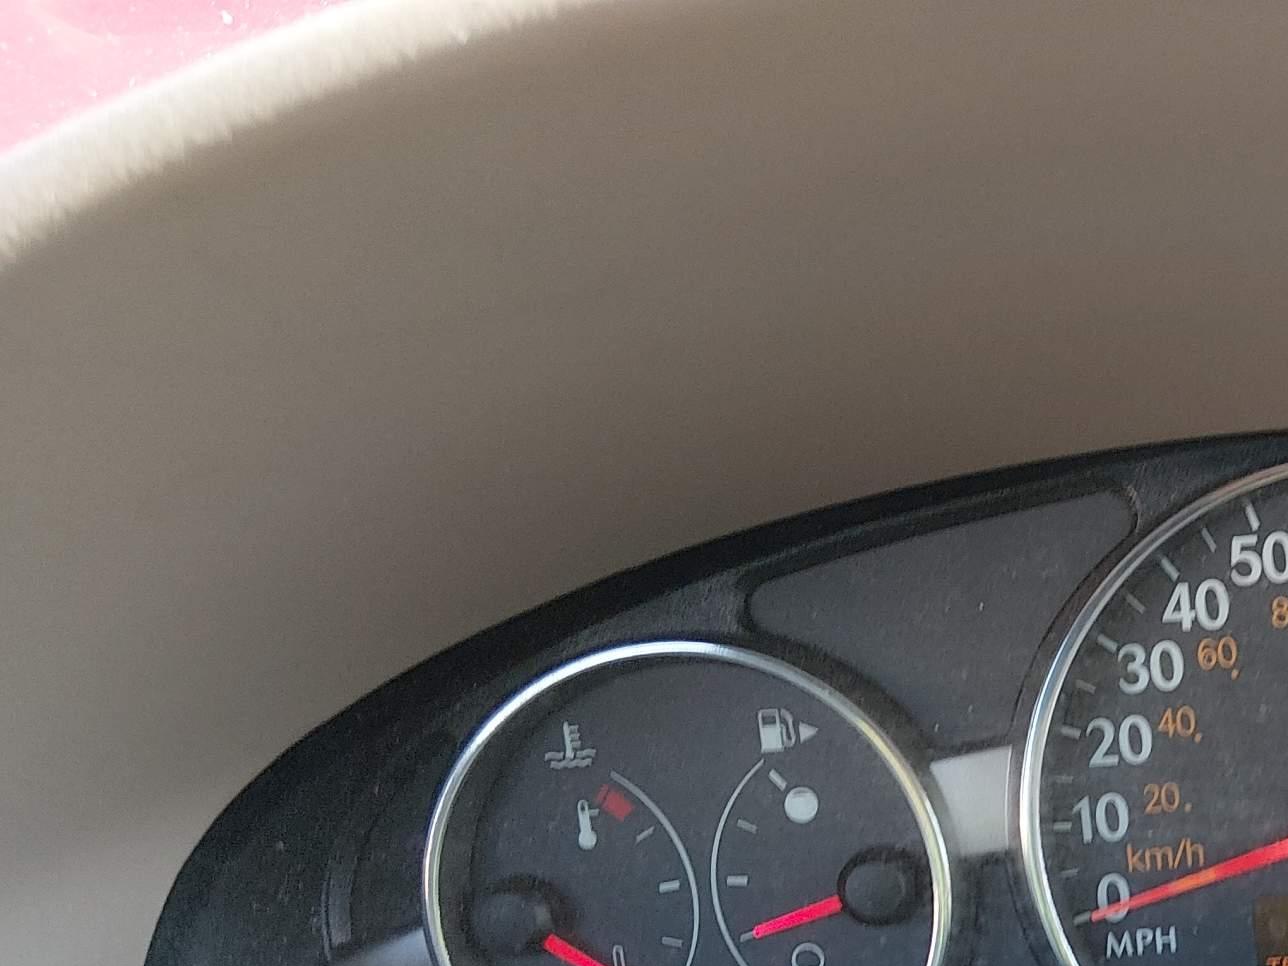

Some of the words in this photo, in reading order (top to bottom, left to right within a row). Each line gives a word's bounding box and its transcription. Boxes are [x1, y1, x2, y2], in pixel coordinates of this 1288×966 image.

[1162, 578, 1229, 632] 40
[1118, 639, 1184, 694] 30
[1197, 637, 1238, 670] 60
[1086, 715, 1153, 768] 20
[1158, 704, 1196, 737] 40
[1071, 792, 1129, 844] 10
[1144, 782, 1181, 813] 20
[1127, 838, 1205, 873] km/h
[1097, 873, 1130, 923] 0
[1105, 926, 1178, 959] MPH
